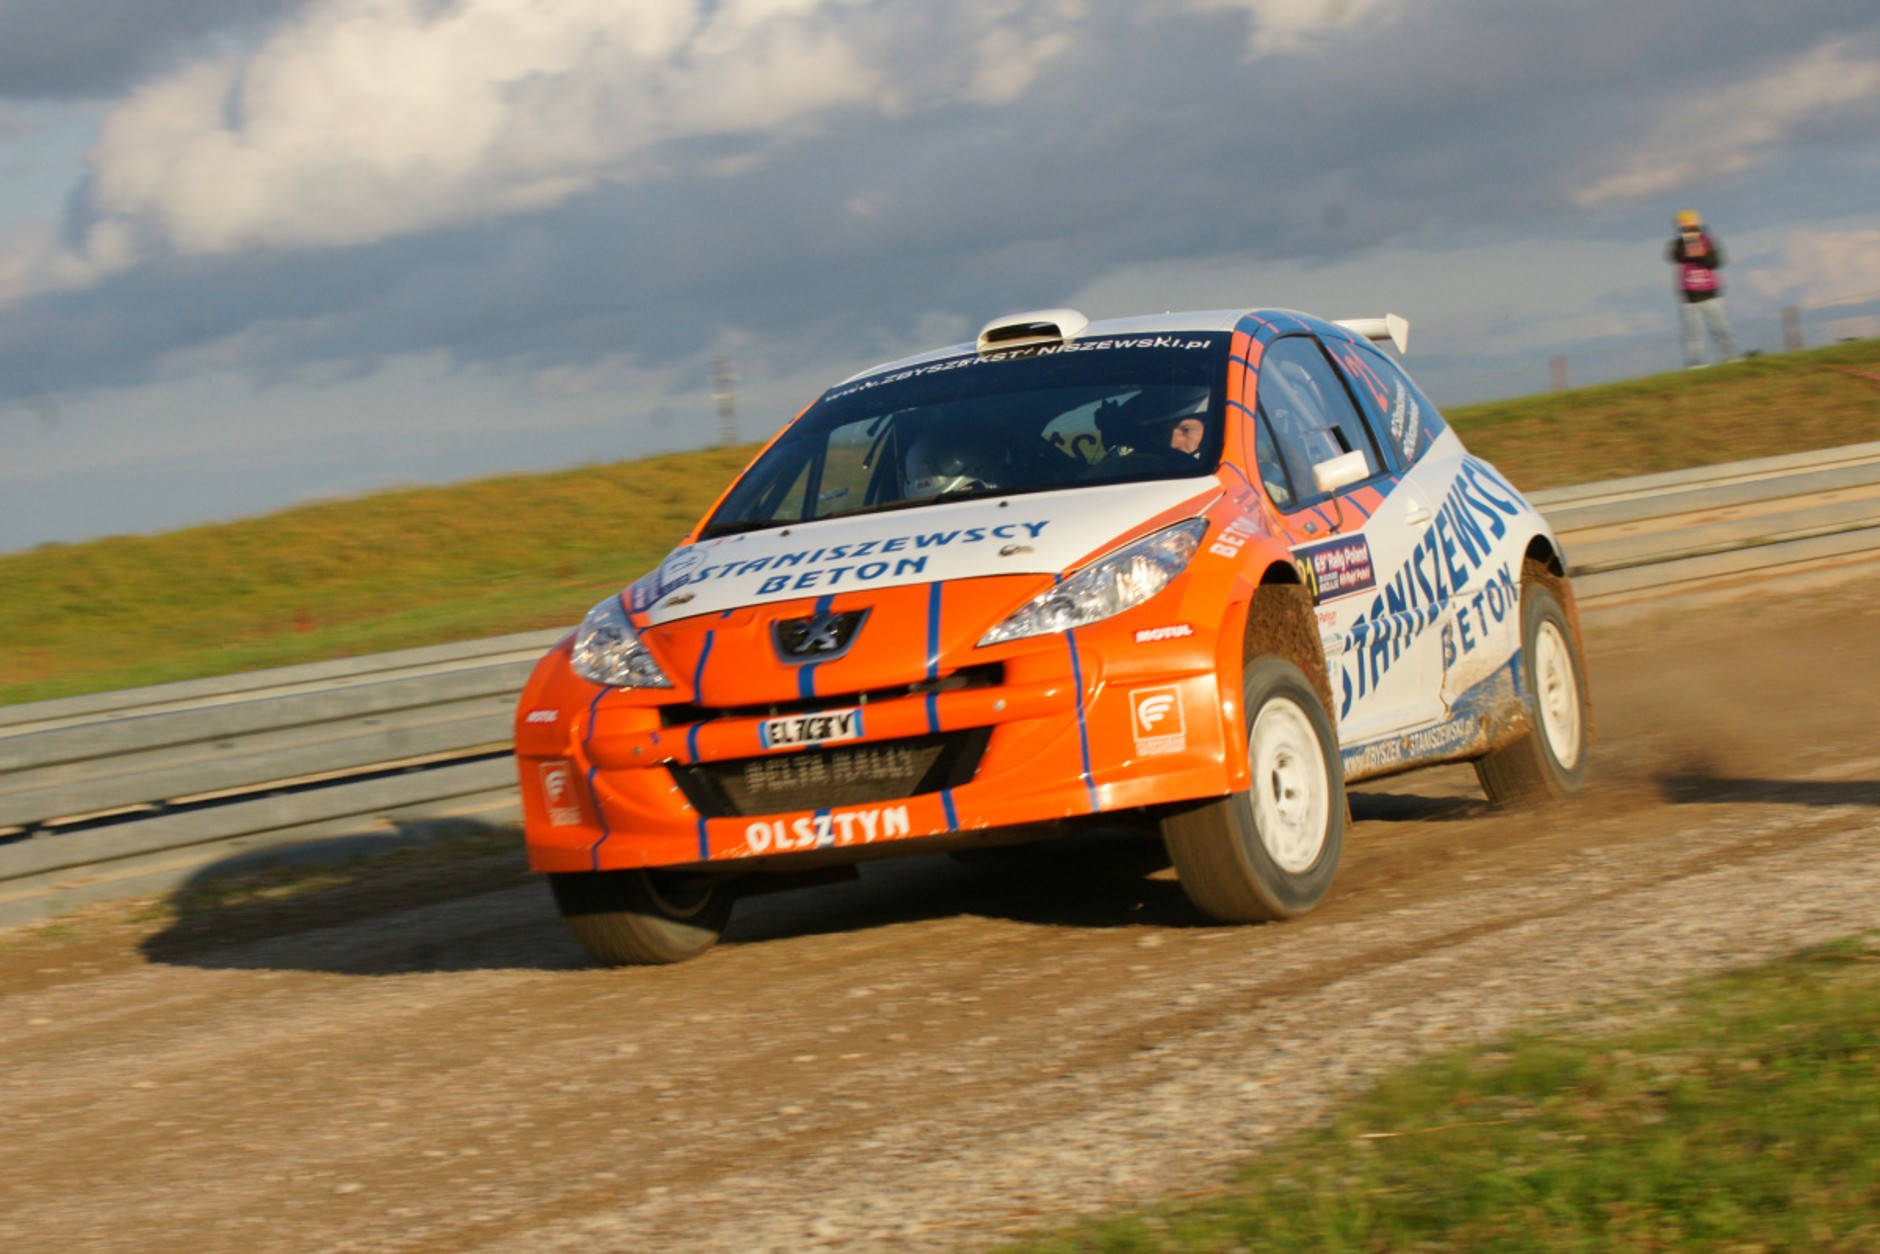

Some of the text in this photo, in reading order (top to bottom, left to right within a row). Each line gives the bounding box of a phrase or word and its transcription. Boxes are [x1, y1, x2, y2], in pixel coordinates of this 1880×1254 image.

[689, 520, 1051, 585] STANISZEWSCY
[754, 555, 929, 596] BETON
[1136, 624, 1193, 643] MOTUL
[1441, 561, 1518, 670] BETON
[745, 805, 910, 852] OLSZTYN
